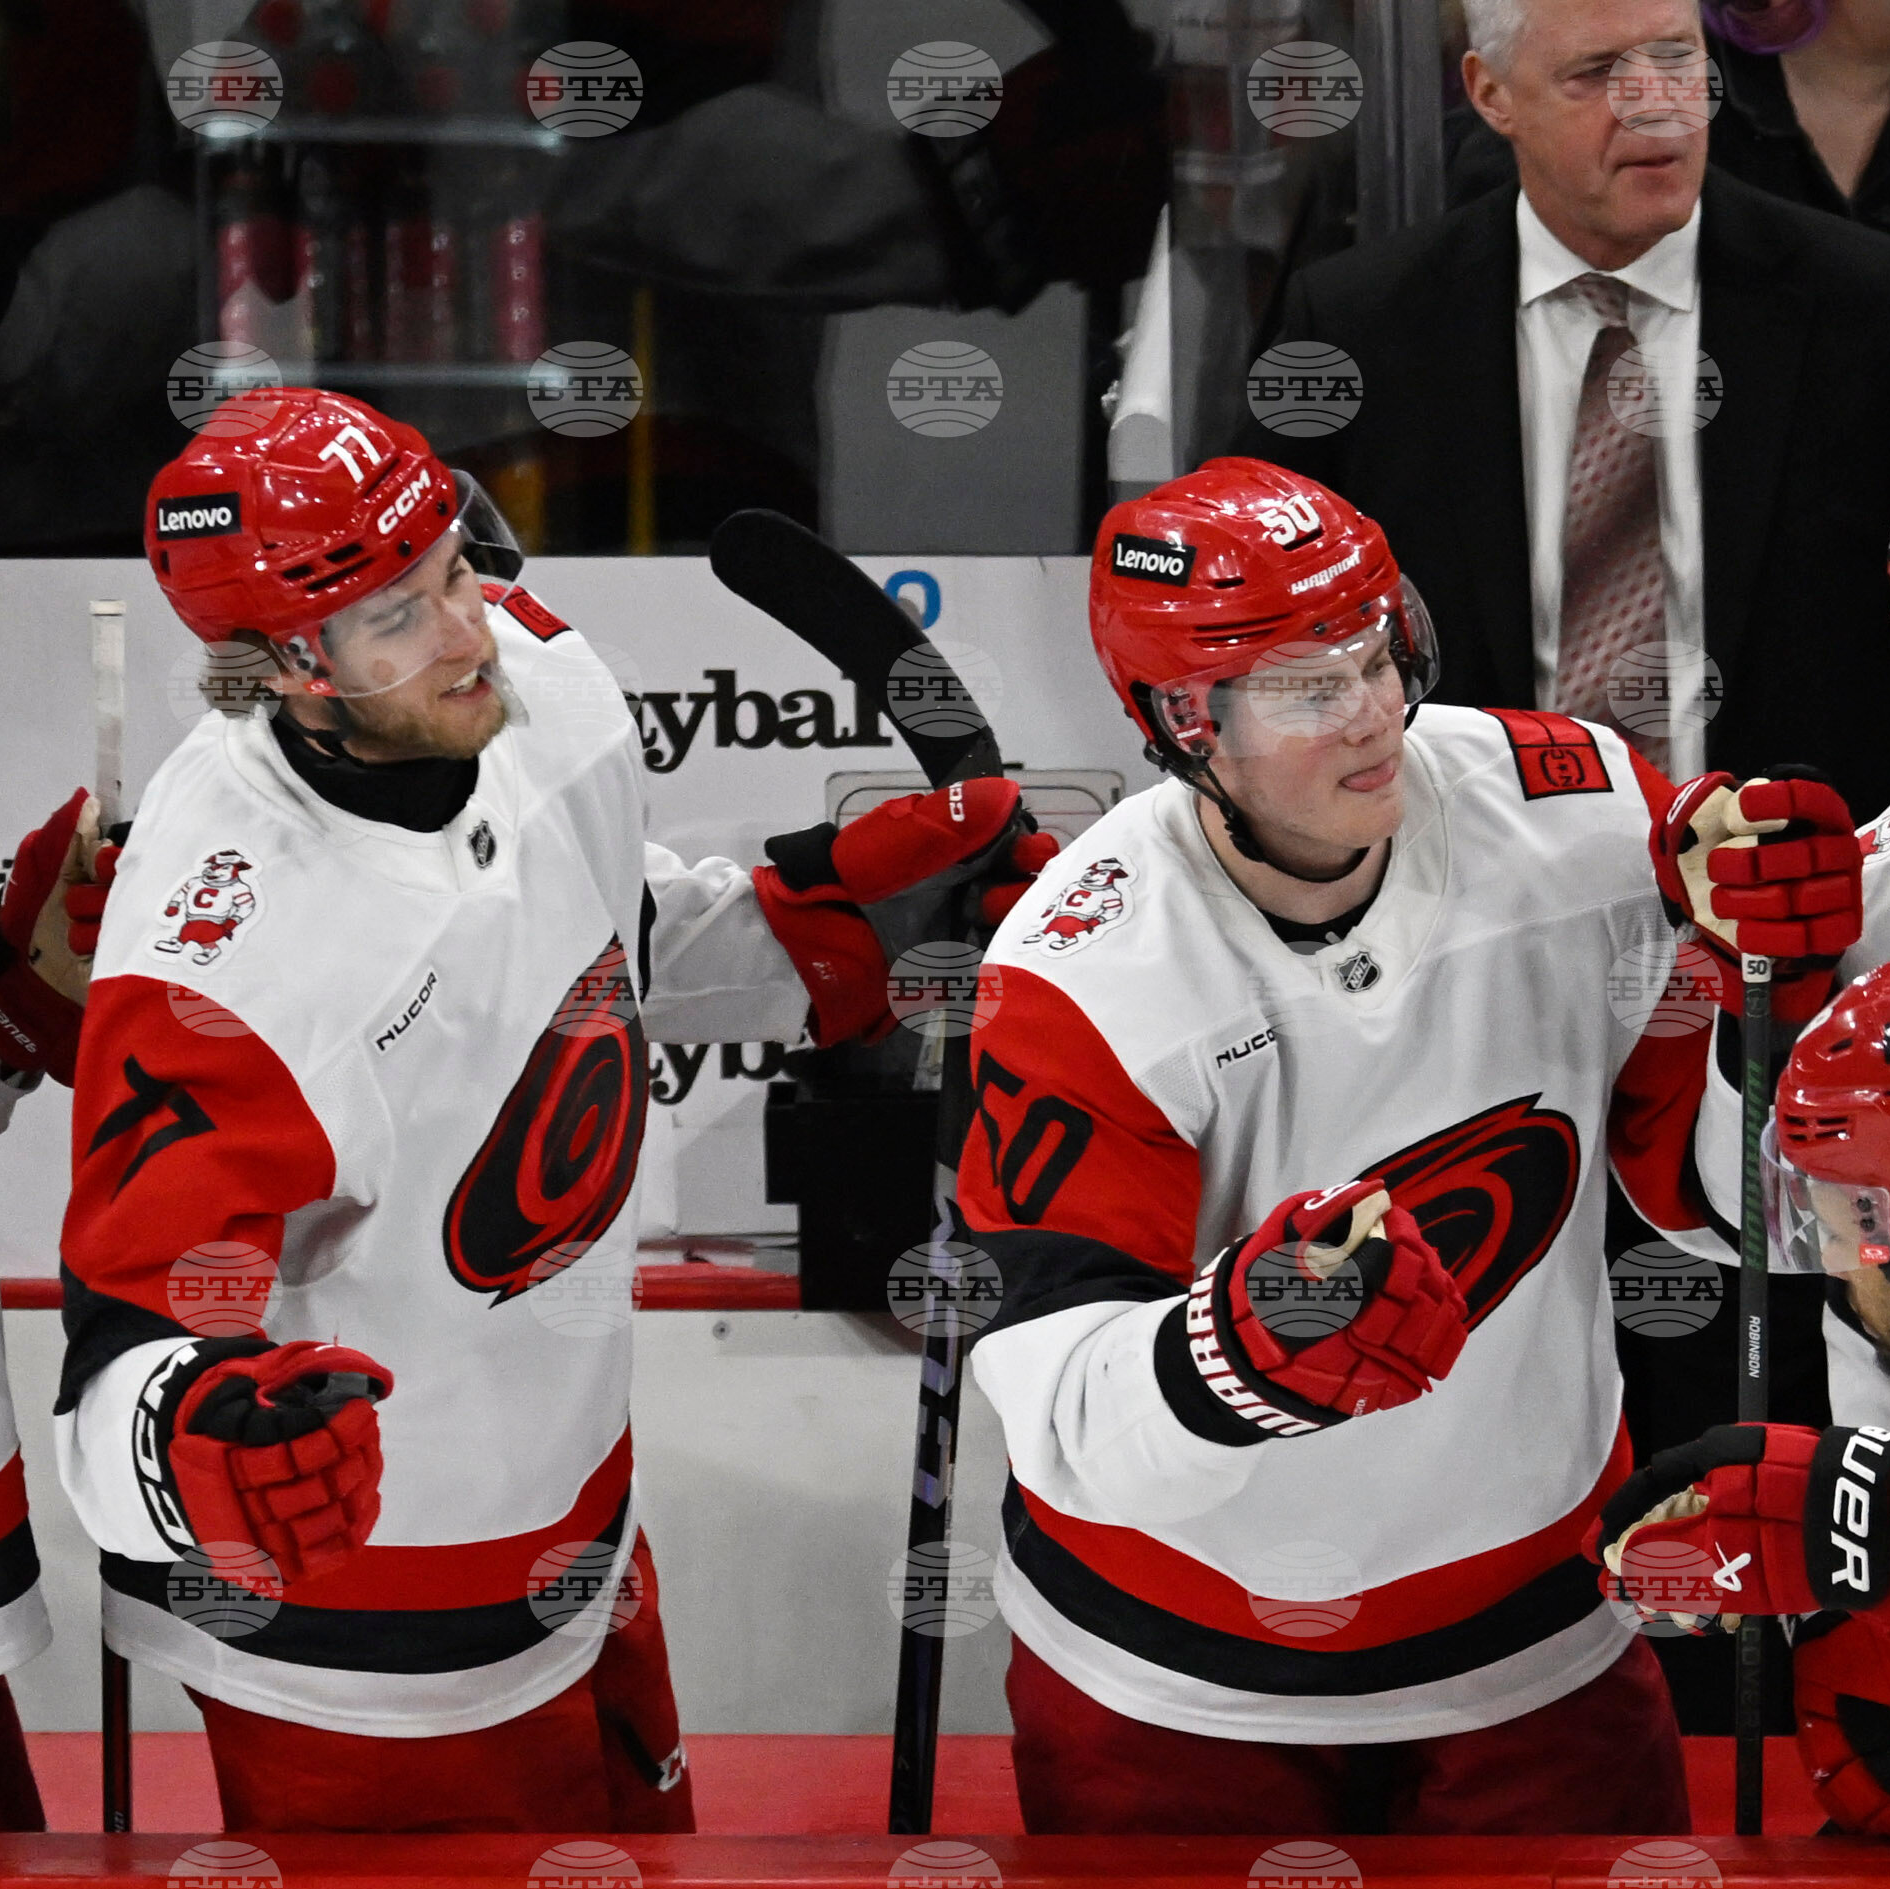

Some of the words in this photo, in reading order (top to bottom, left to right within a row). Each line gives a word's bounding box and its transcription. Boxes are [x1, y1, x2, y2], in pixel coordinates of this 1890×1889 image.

[318, 425, 382, 483] 77
[159, 507, 232, 532] Lenovo
[377, 468, 431, 535] CCM
[1257, 493, 1320, 545] 50
[1116, 542, 1185, 576] Lenovo
[1290, 549, 1361, 596] WARRIOR
[193, 888, 219, 909] C
[1066, 890, 1092, 907] C
[1747, 959, 1768, 975] 50
[376, 971, 437, 1051] NUCOR
[1216, 1029, 1276, 1069] NUCO
[1749, 1315, 1761, 1378] ROBINSON
